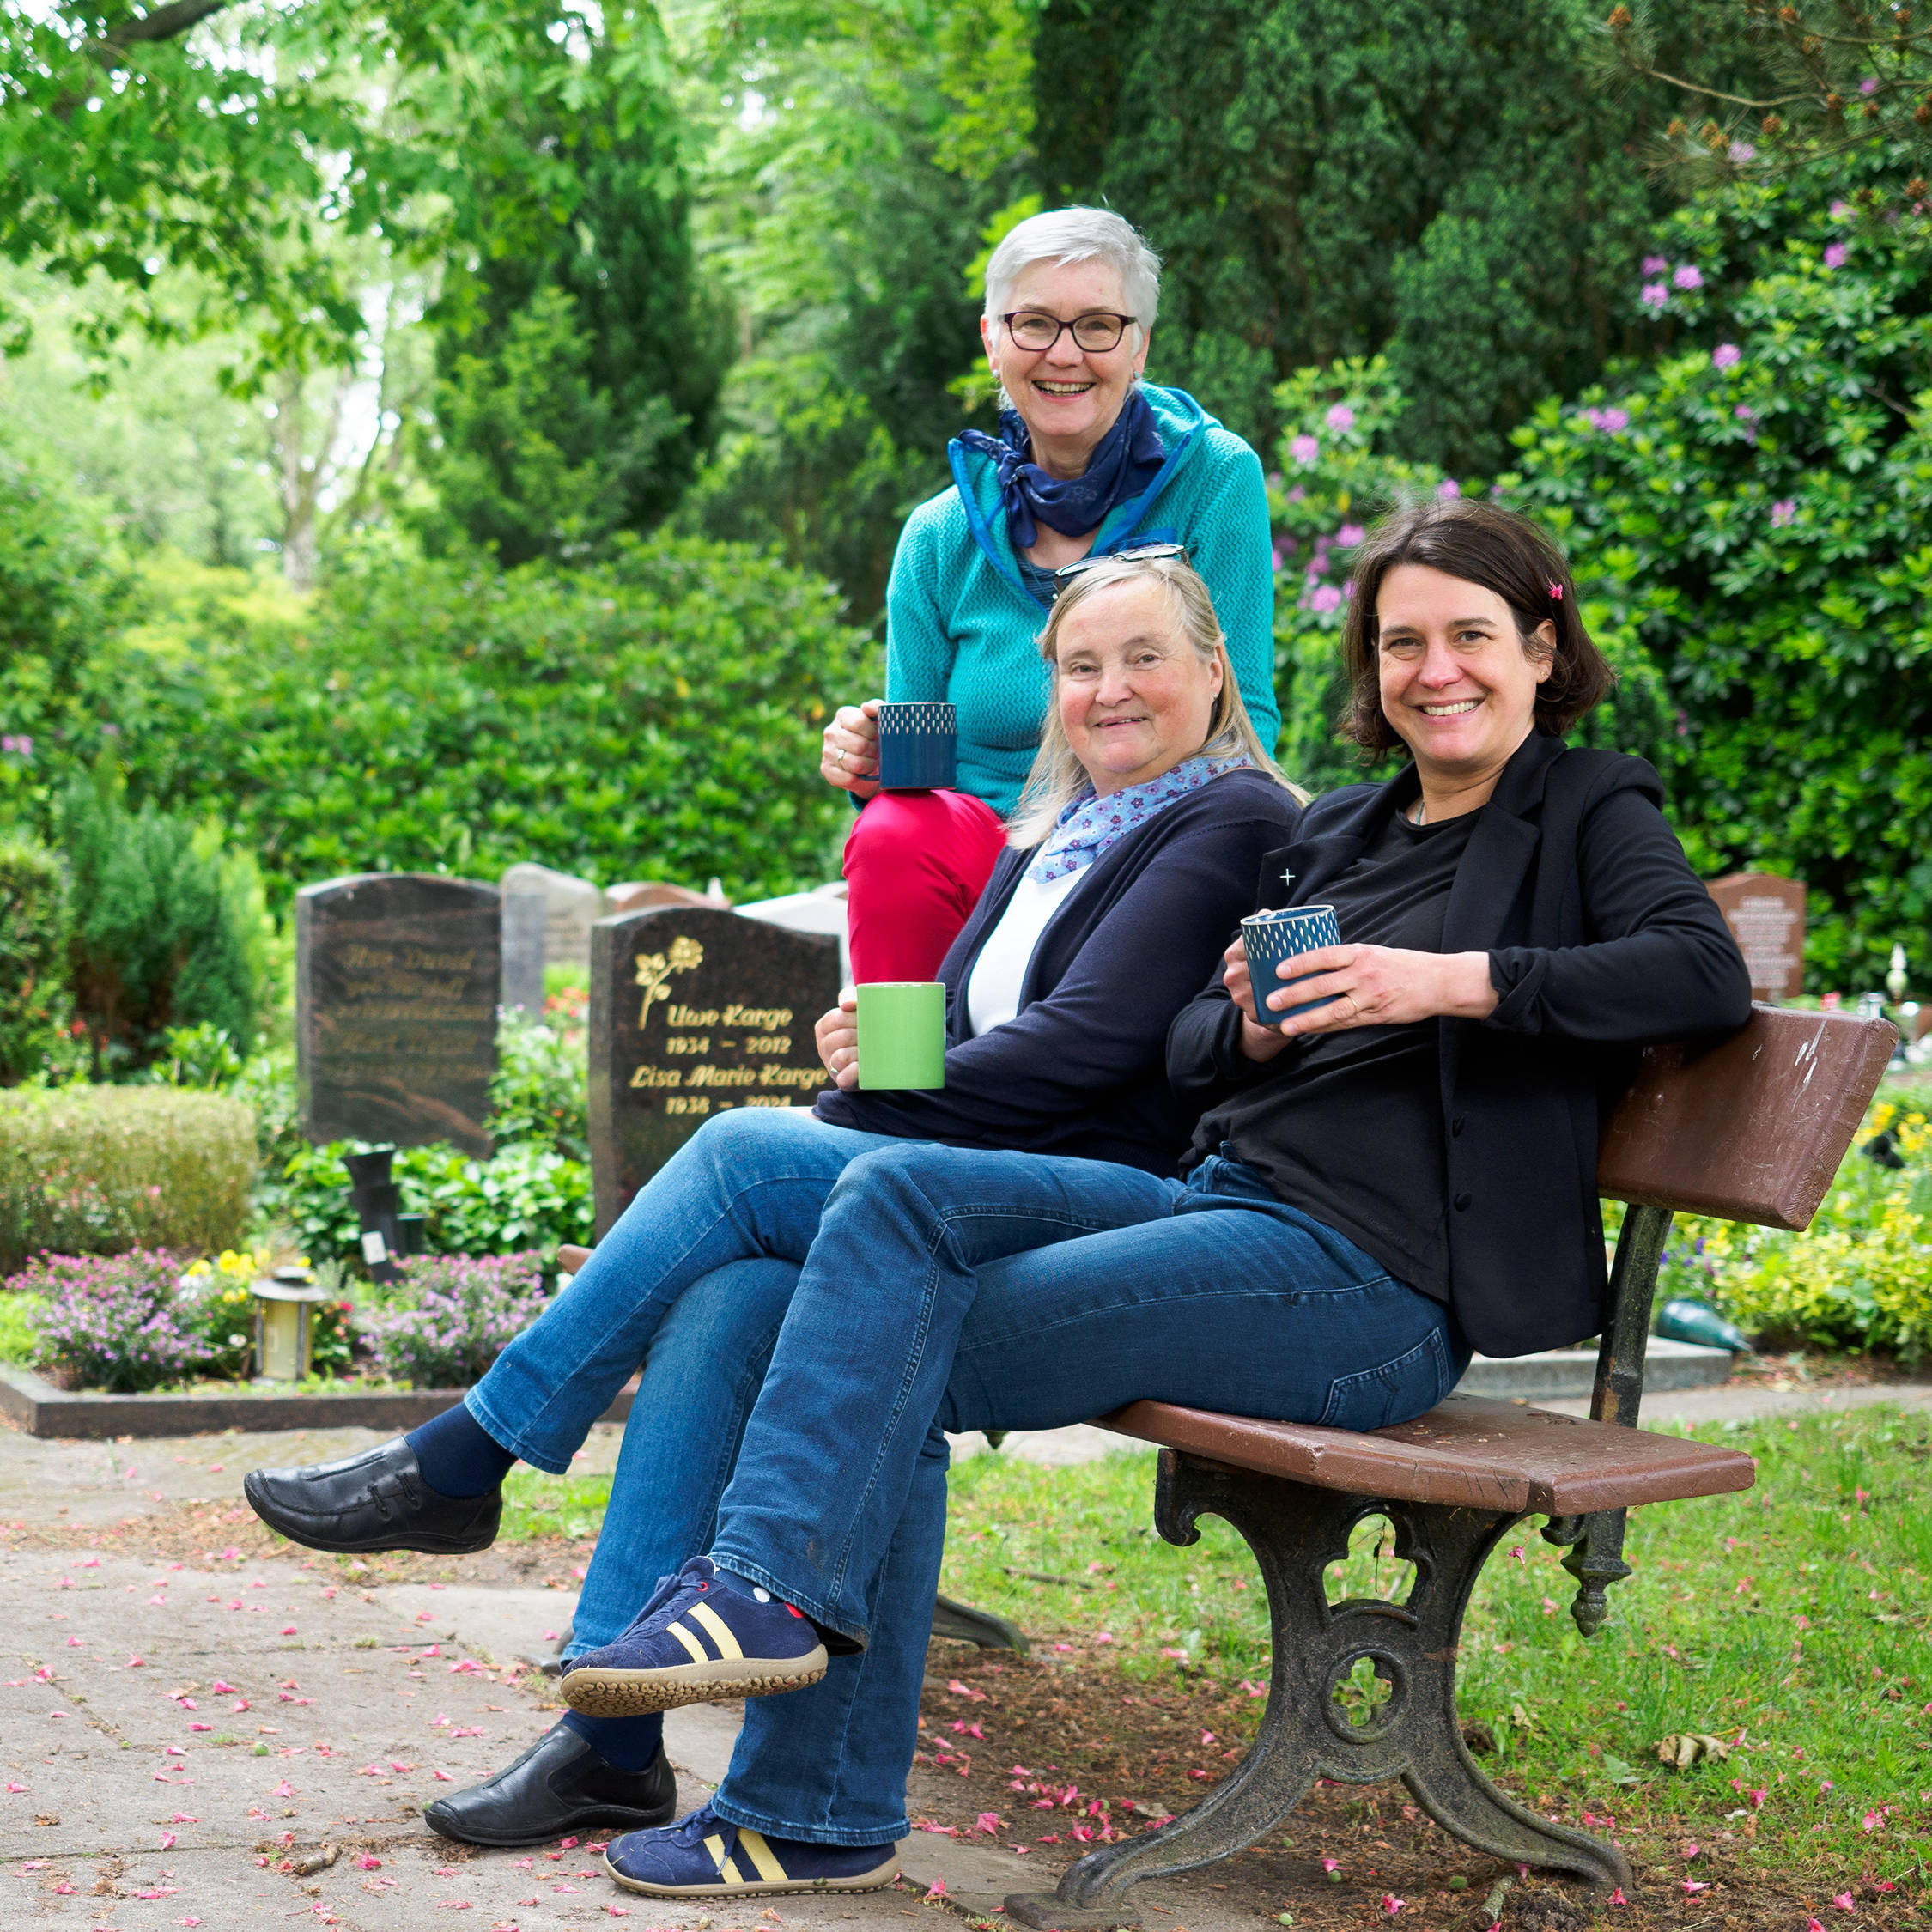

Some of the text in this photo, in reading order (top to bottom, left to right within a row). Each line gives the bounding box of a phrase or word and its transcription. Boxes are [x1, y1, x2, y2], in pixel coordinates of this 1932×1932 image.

[666, 1004, 793, 1031] Uwe Karge
[666, 1036, 710, 1055] 1934
[745, 1036, 792, 1054] 2012
[629, 1064, 829, 1091] Lisa Marie Karge
